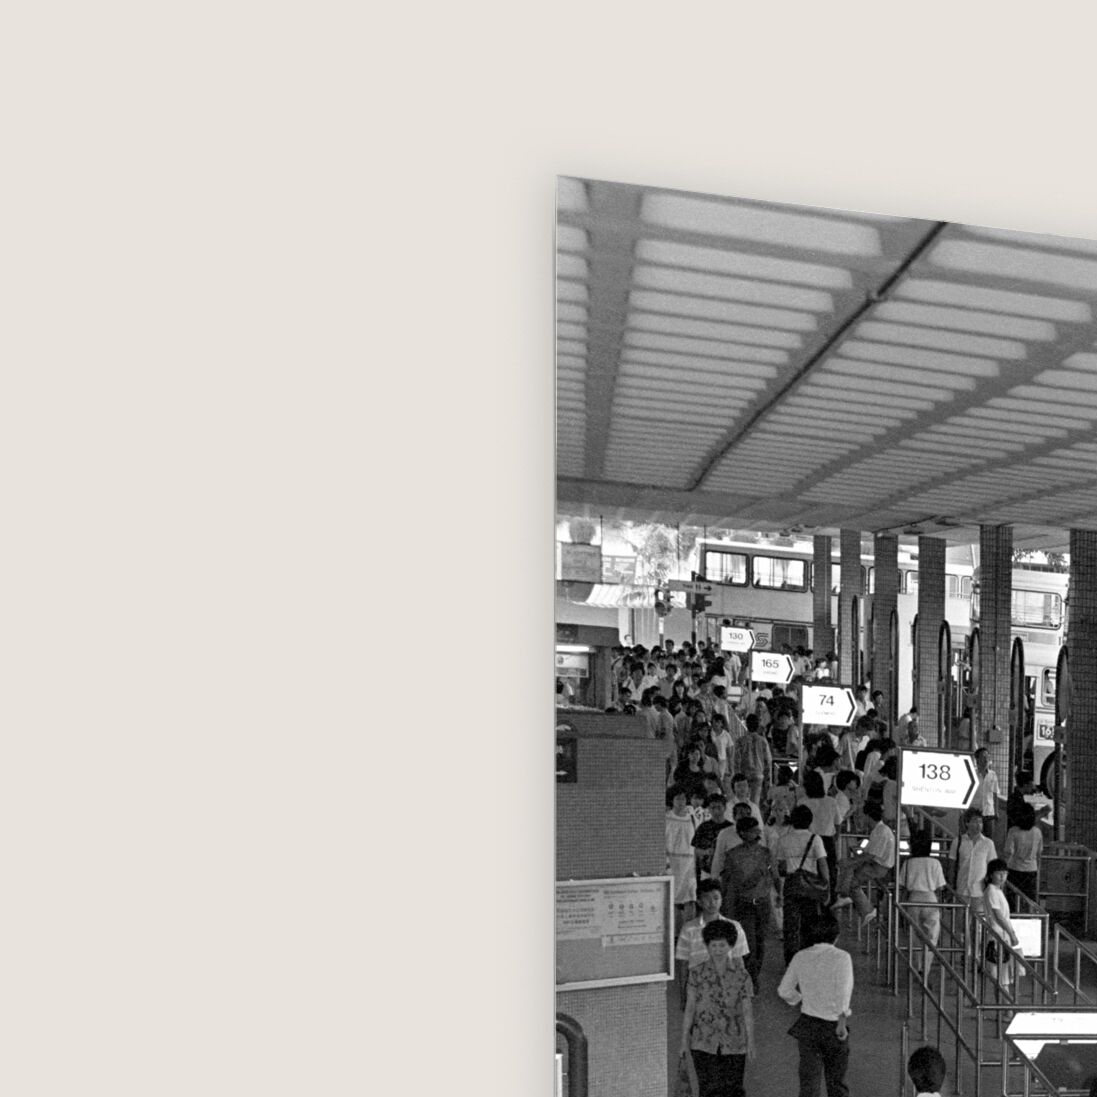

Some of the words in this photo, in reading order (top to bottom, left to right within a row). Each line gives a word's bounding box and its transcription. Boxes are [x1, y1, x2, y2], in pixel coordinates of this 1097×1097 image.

[729, 632, 744, 641] 130
[762, 659, 779, 669] 165
[819, 694, 834, 706] 74
[919, 764, 951, 781] 138
